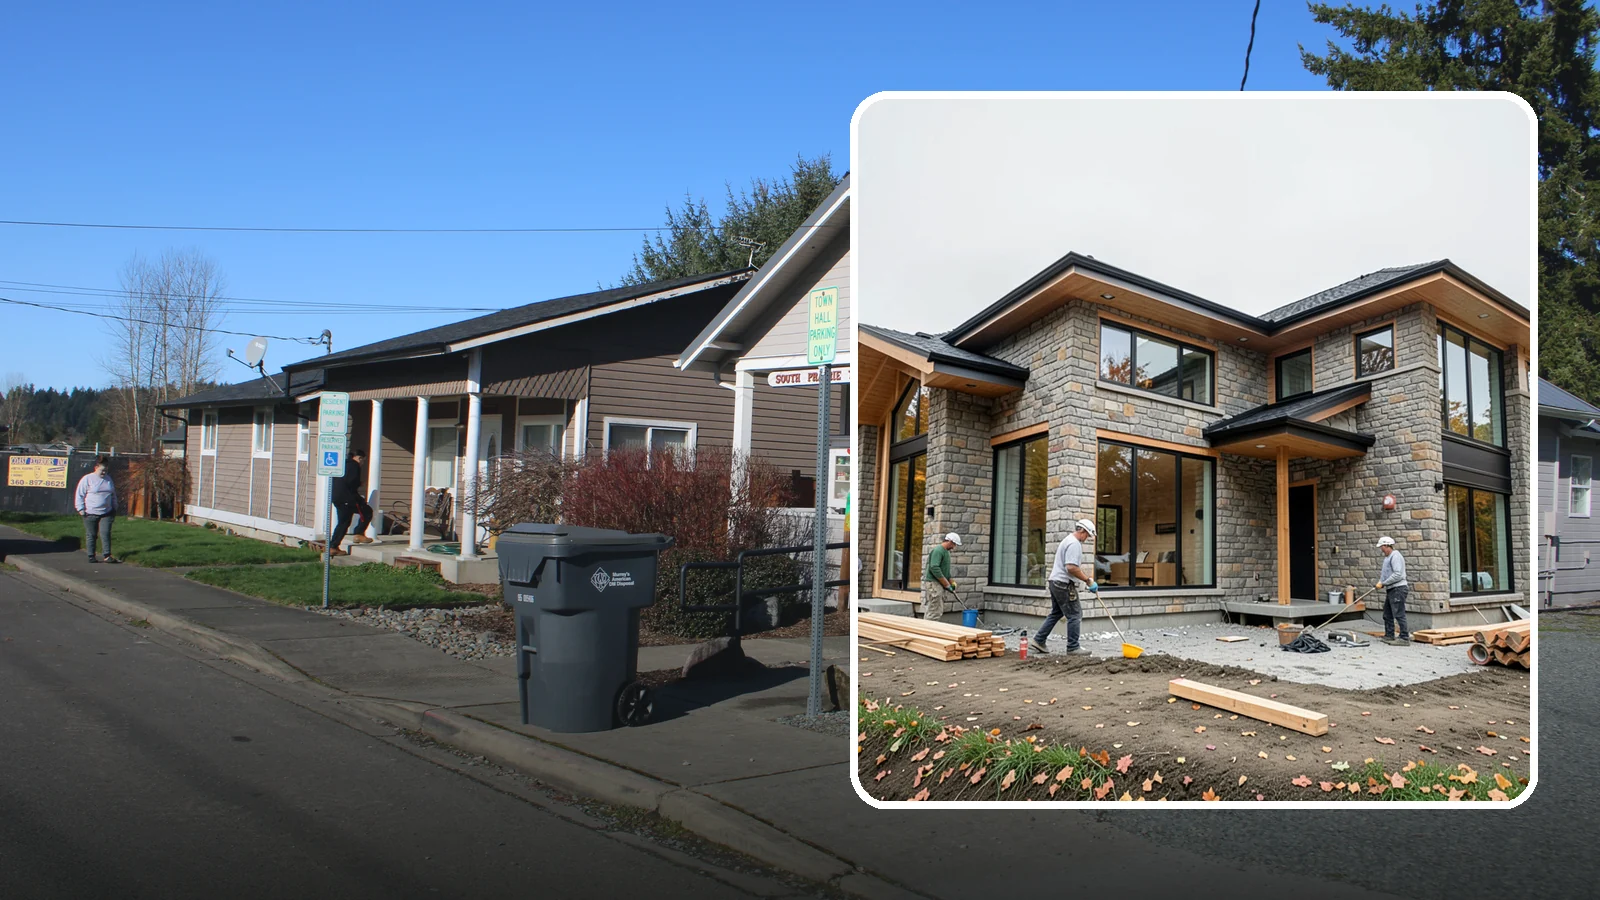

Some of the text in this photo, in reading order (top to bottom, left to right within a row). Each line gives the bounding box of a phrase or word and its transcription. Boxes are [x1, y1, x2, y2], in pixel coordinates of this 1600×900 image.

[815, 294, 832, 308] TOWN
[814, 312, 830, 324] HALL
[810, 326, 836, 340] PARKING
[814, 344, 830, 357] ONLY
[776, 374, 800, 384] SOUTH
